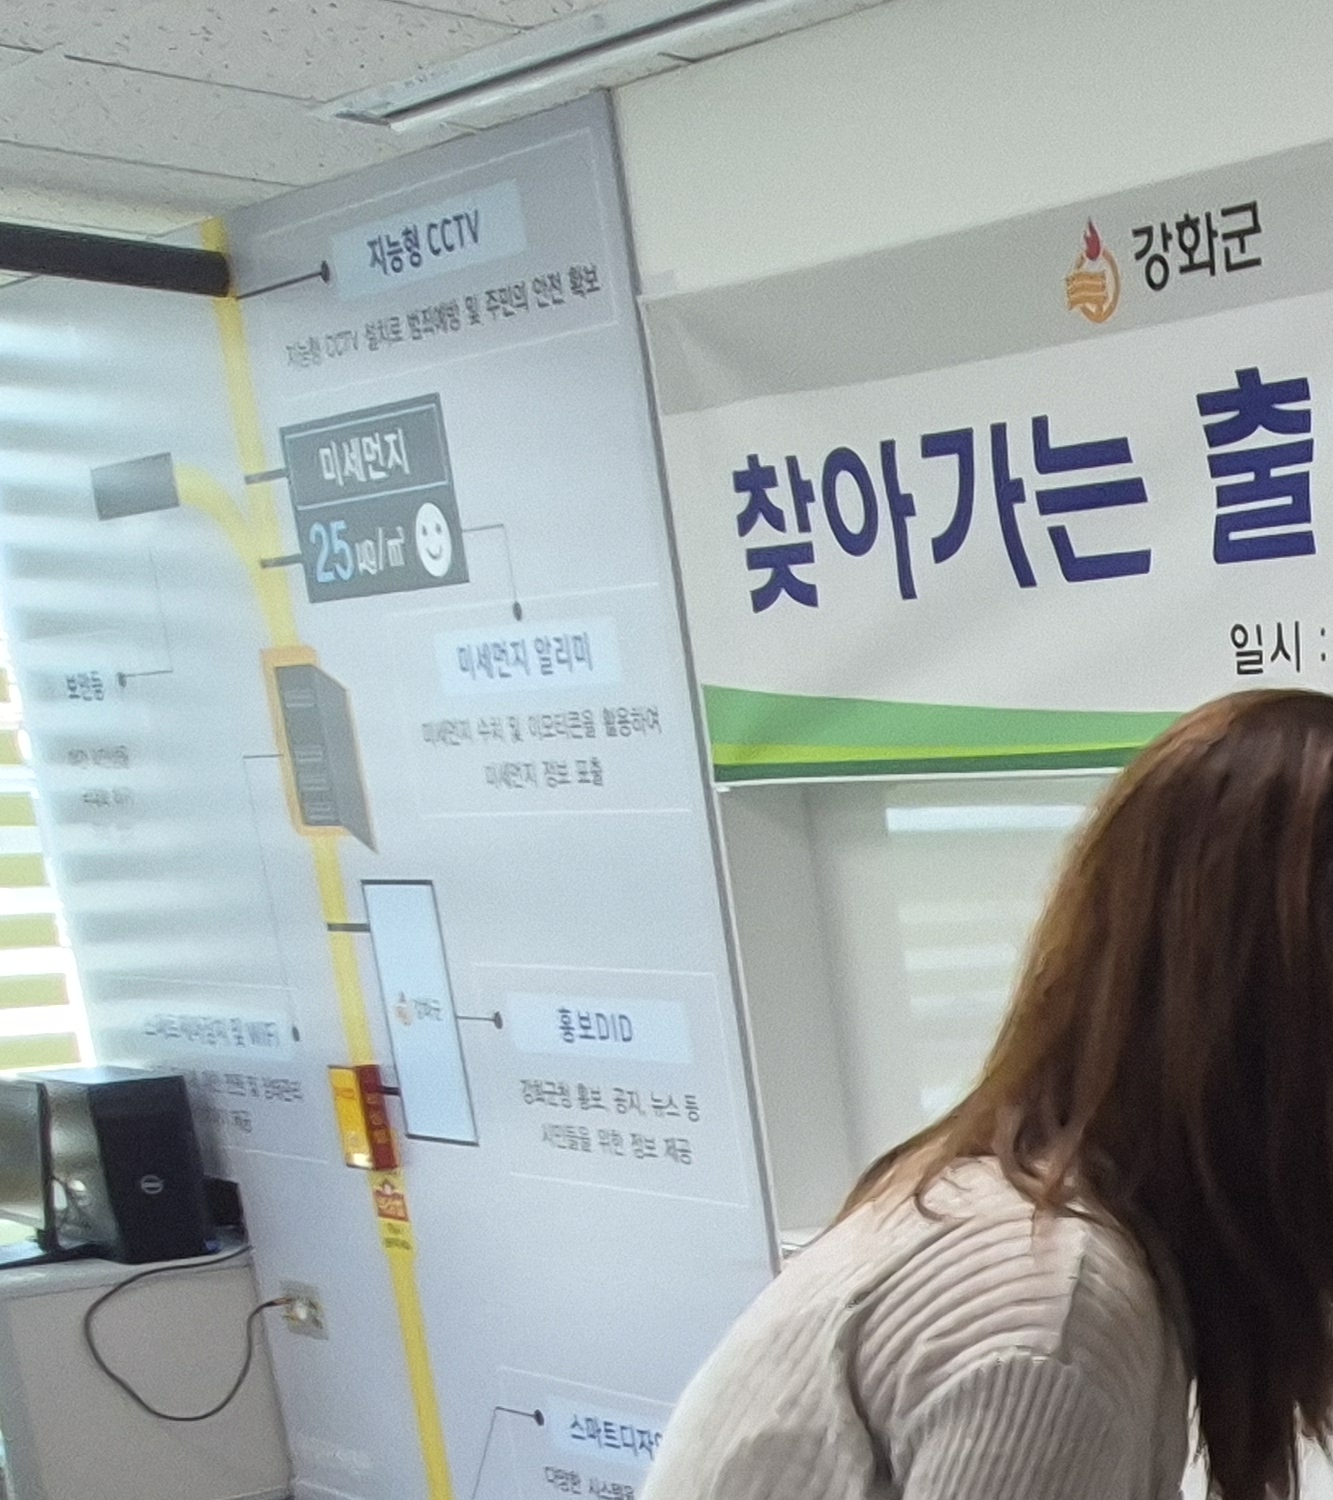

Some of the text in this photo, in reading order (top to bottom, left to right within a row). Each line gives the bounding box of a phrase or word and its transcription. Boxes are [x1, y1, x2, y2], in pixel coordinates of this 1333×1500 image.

[367, 209, 480, 275] 지능형 CCTV
[1131, 200, 1262, 292] 강화군
[465, 294, 484, 326] 및
[485, 282, 528, 317] 주민의
[531, 271, 565, 308] 안전
[567, 262, 601, 298] 확보
[319, 428, 410, 486] 미세먼지
[732, 414, 1152, 614] 찾아가는
[457, 631, 593, 680] 미세먼지 알리미
[1230, 620, 1301, 676] 일시
[1320, 627, 1327, 662] :
[558, 1007, 633, 1044] 홍보DID
[651, 1091, 681, 1118] 뉴스
[684, 1094, 700, 1123] 등
